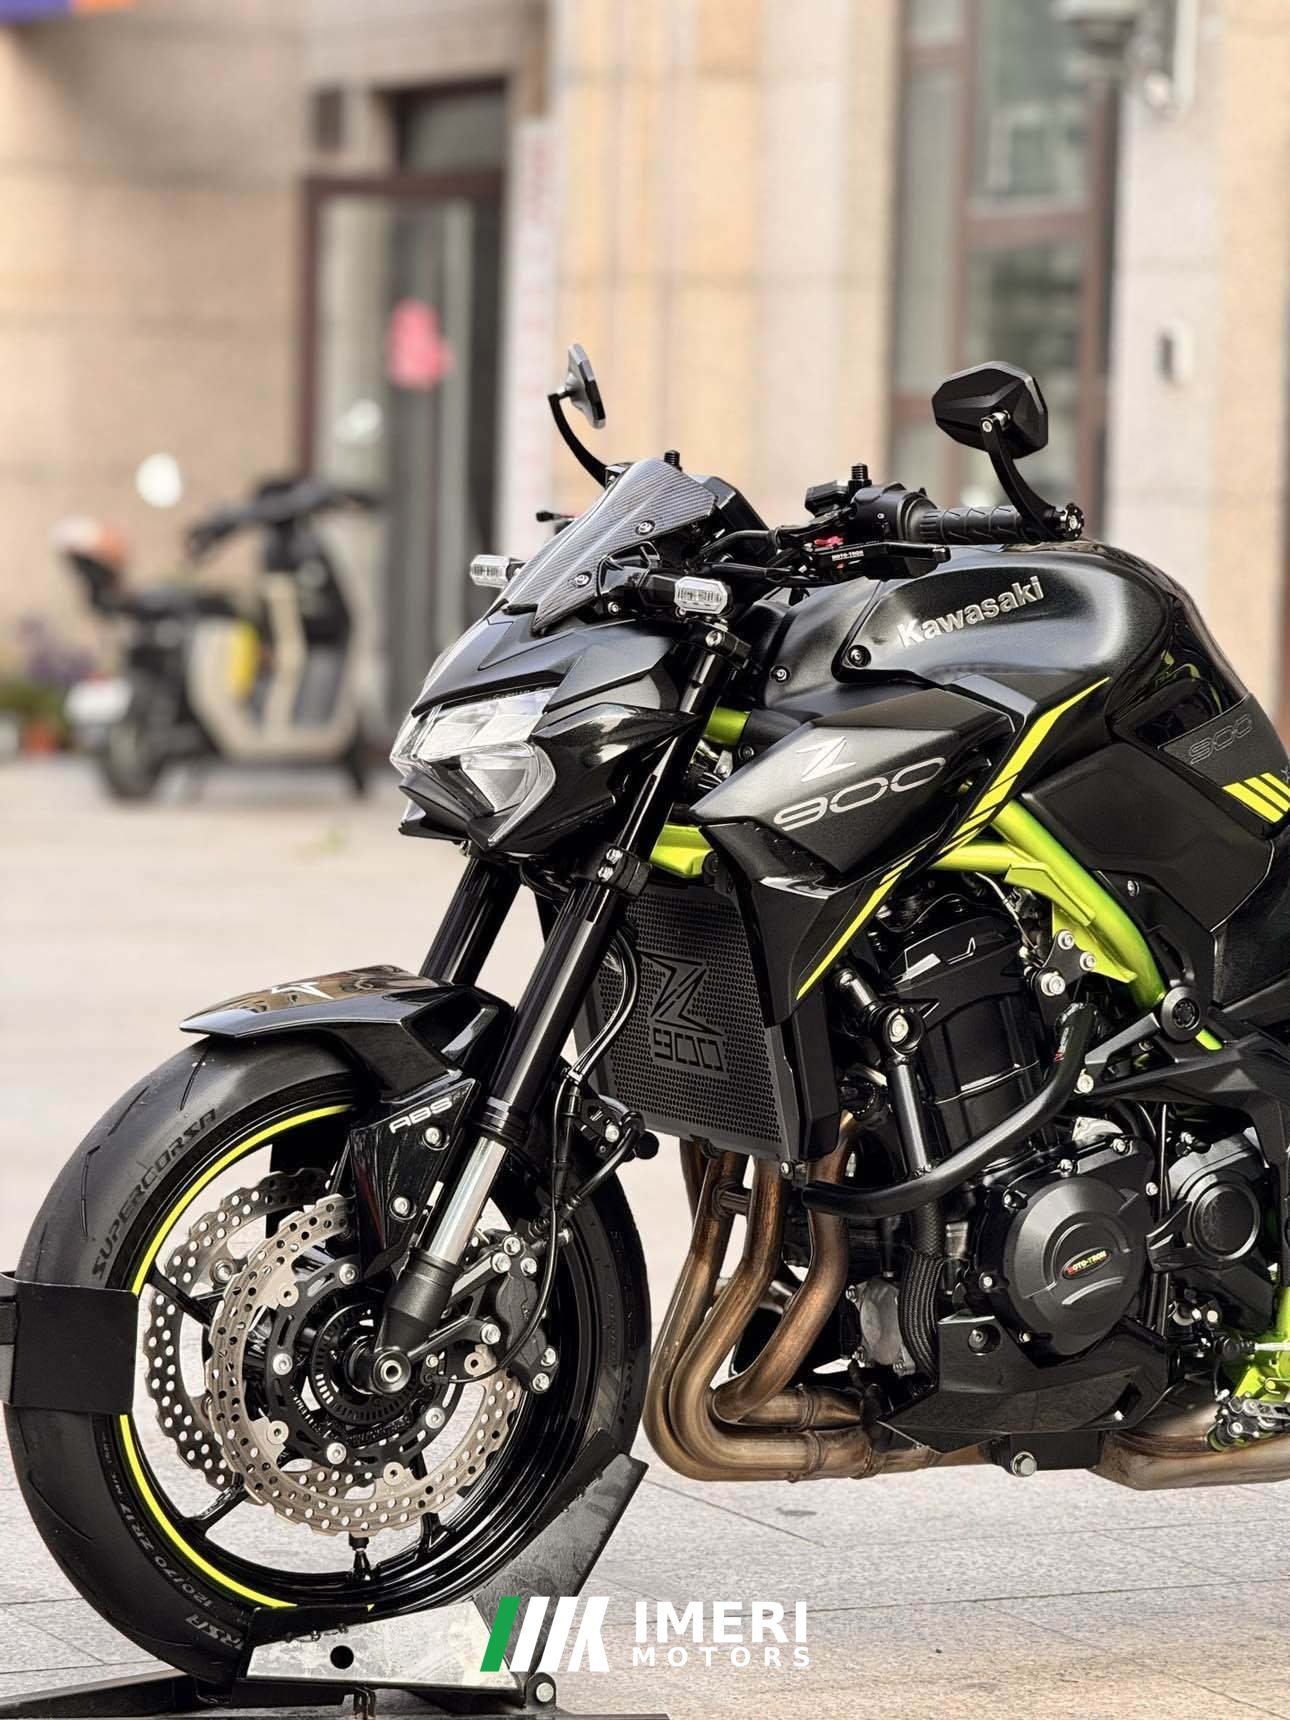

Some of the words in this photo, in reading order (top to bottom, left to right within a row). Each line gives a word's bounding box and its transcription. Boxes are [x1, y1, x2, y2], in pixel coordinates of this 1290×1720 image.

[896, 575, 1045, 648] Kawasaki
[795, 735, 857, 783] Z
[1188, 713, 1253, 766] 900
[773, 757, 947, 832] 900
[652, 1027, 724, 1071] 900
[389, 1097, 453, 1134] ABS
[92, 1108, 217, 1281] SUPERCORSA
[155, 1556, 213, 1607] 120/70
